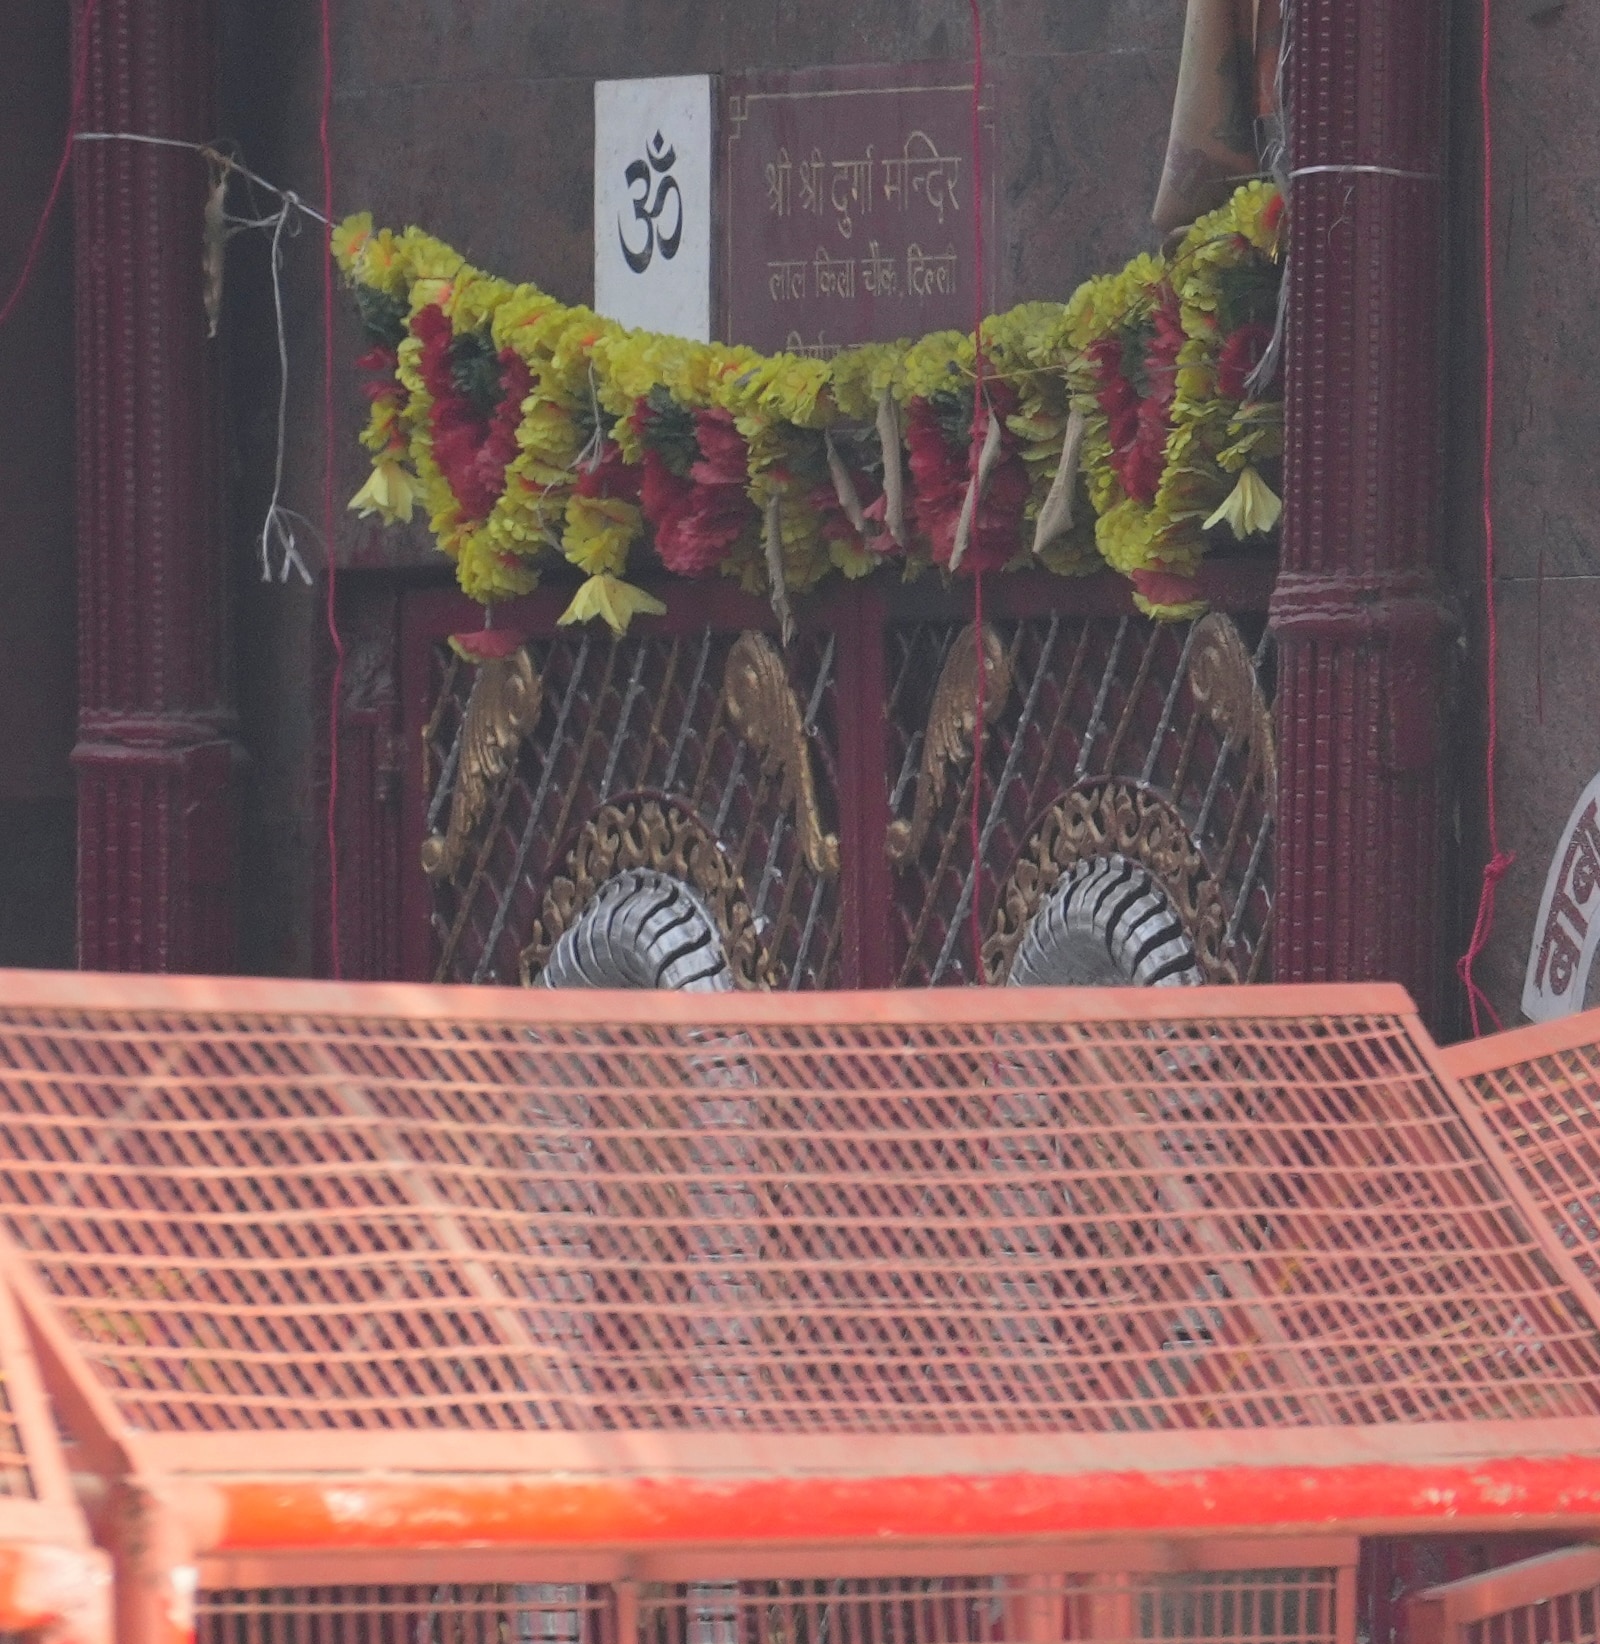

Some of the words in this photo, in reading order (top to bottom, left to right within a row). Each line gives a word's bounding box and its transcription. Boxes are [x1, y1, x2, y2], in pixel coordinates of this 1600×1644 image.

[764, 146, 793, 217] श्री
[800, 146, 825, 217] श्री
[831, 145, 875, 238] दुर्गा
[881, 130, 962, 225] मन्दिर
[767, 260, 808, 301] लाल
[813, 246, 856, 299] किला
